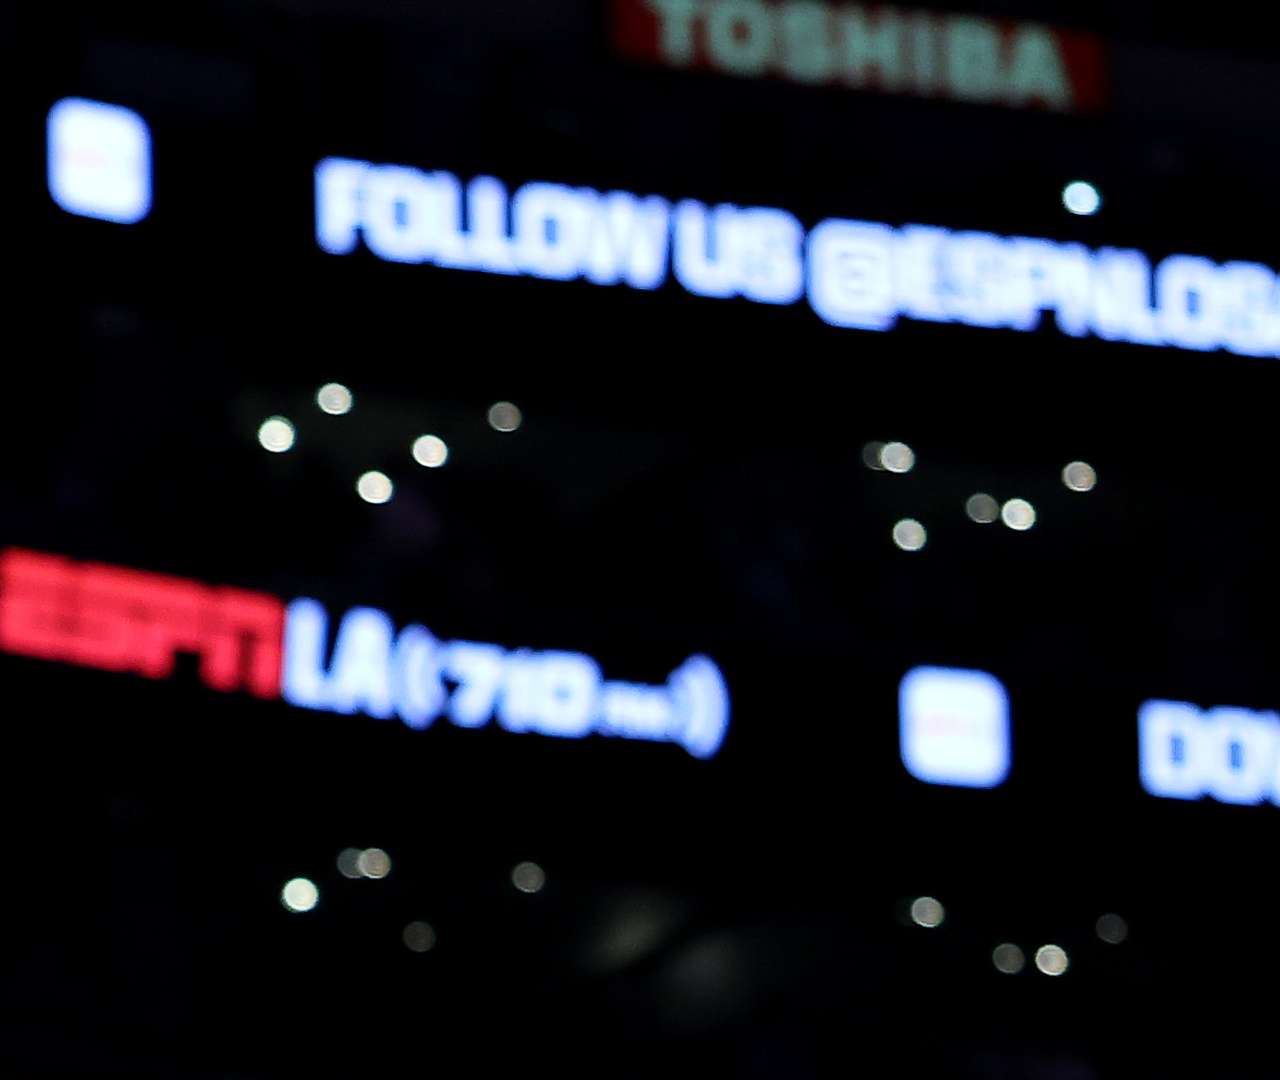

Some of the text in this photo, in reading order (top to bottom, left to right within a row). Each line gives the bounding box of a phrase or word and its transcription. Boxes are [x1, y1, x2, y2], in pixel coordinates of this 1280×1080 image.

[652, 0, 1072, 108] TOSHIBA
[316, 156, 670, 290] FOLLOW
[672, 198, 806, 305] US
